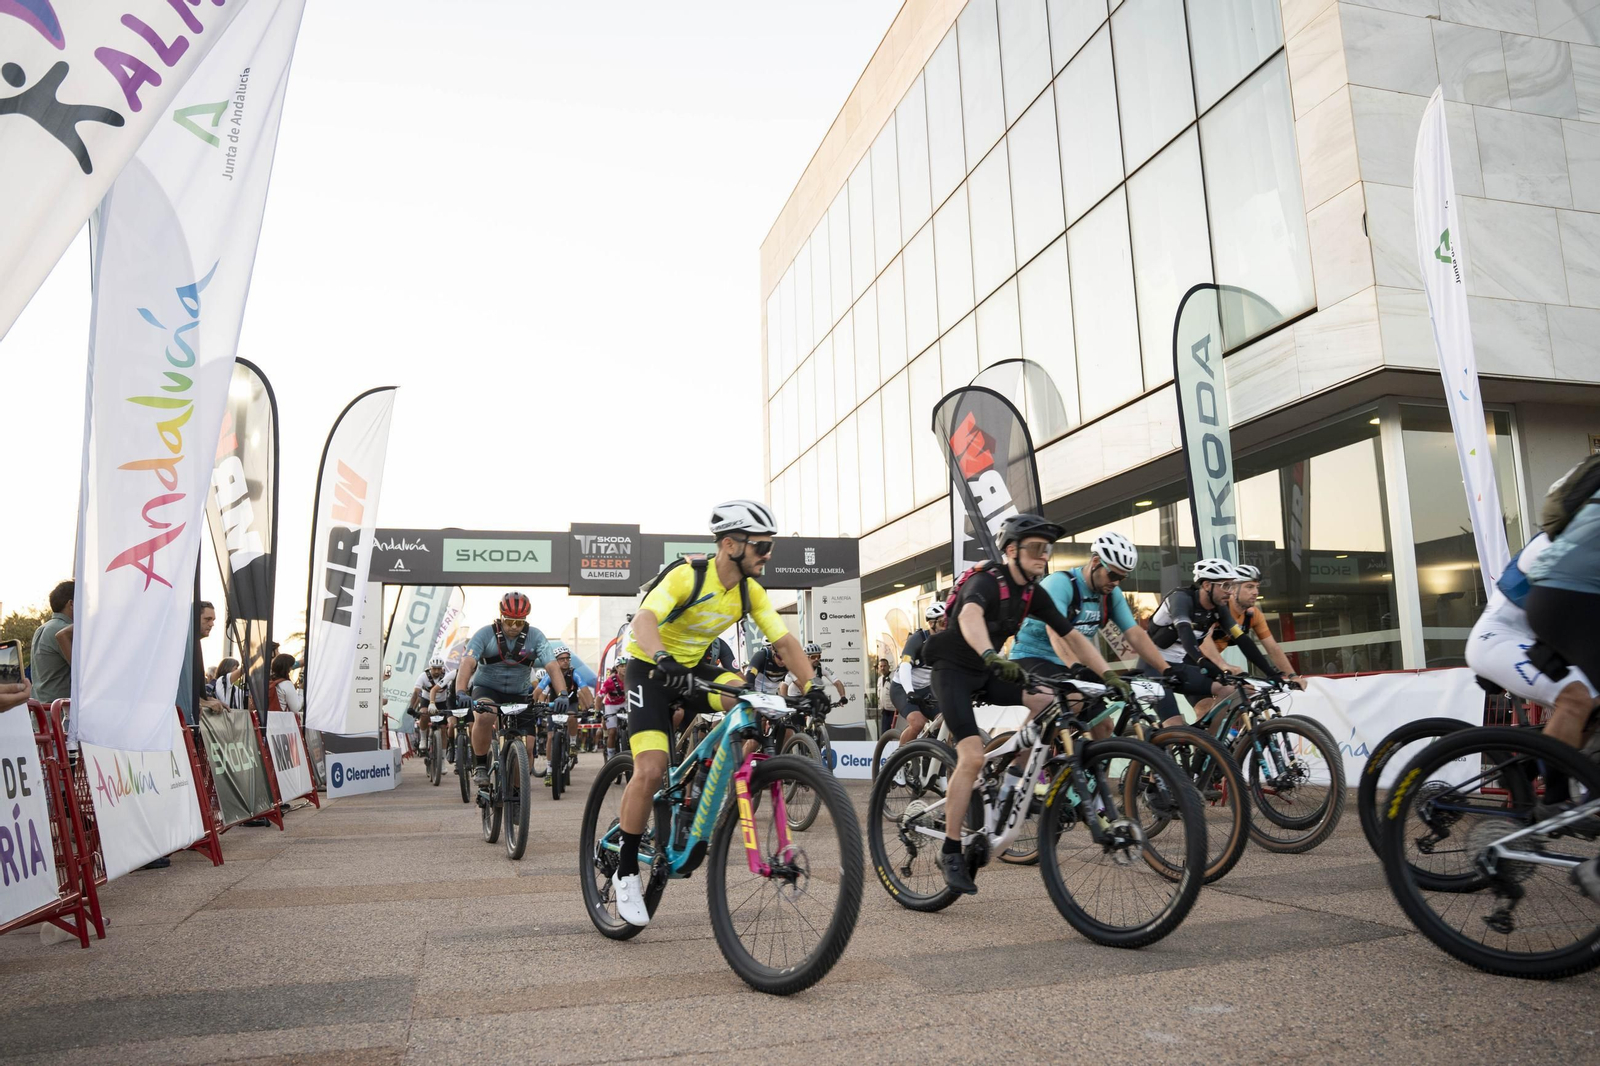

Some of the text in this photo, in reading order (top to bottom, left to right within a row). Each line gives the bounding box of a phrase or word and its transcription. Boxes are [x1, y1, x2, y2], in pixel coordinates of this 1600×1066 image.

[222, 67, 250, 181] Junta de Andalucía
[105, 257, 221, 592] Andalucía
[322, 458, 368, 627] MRW
[372, 537, 430, 552] Andalucía
[574, 535, 631, 555] TITAN
[581, 559, 631, 568] DESERT
[775, 566, 811, 574] DIPUTACIÓN
[820, 566, 845, 574] ALMERÍA
[587, 570, 623, 578] ALMERÍA
[2, 756, 31, 799] DE
[346, 764, 390, 781] Cleardent
